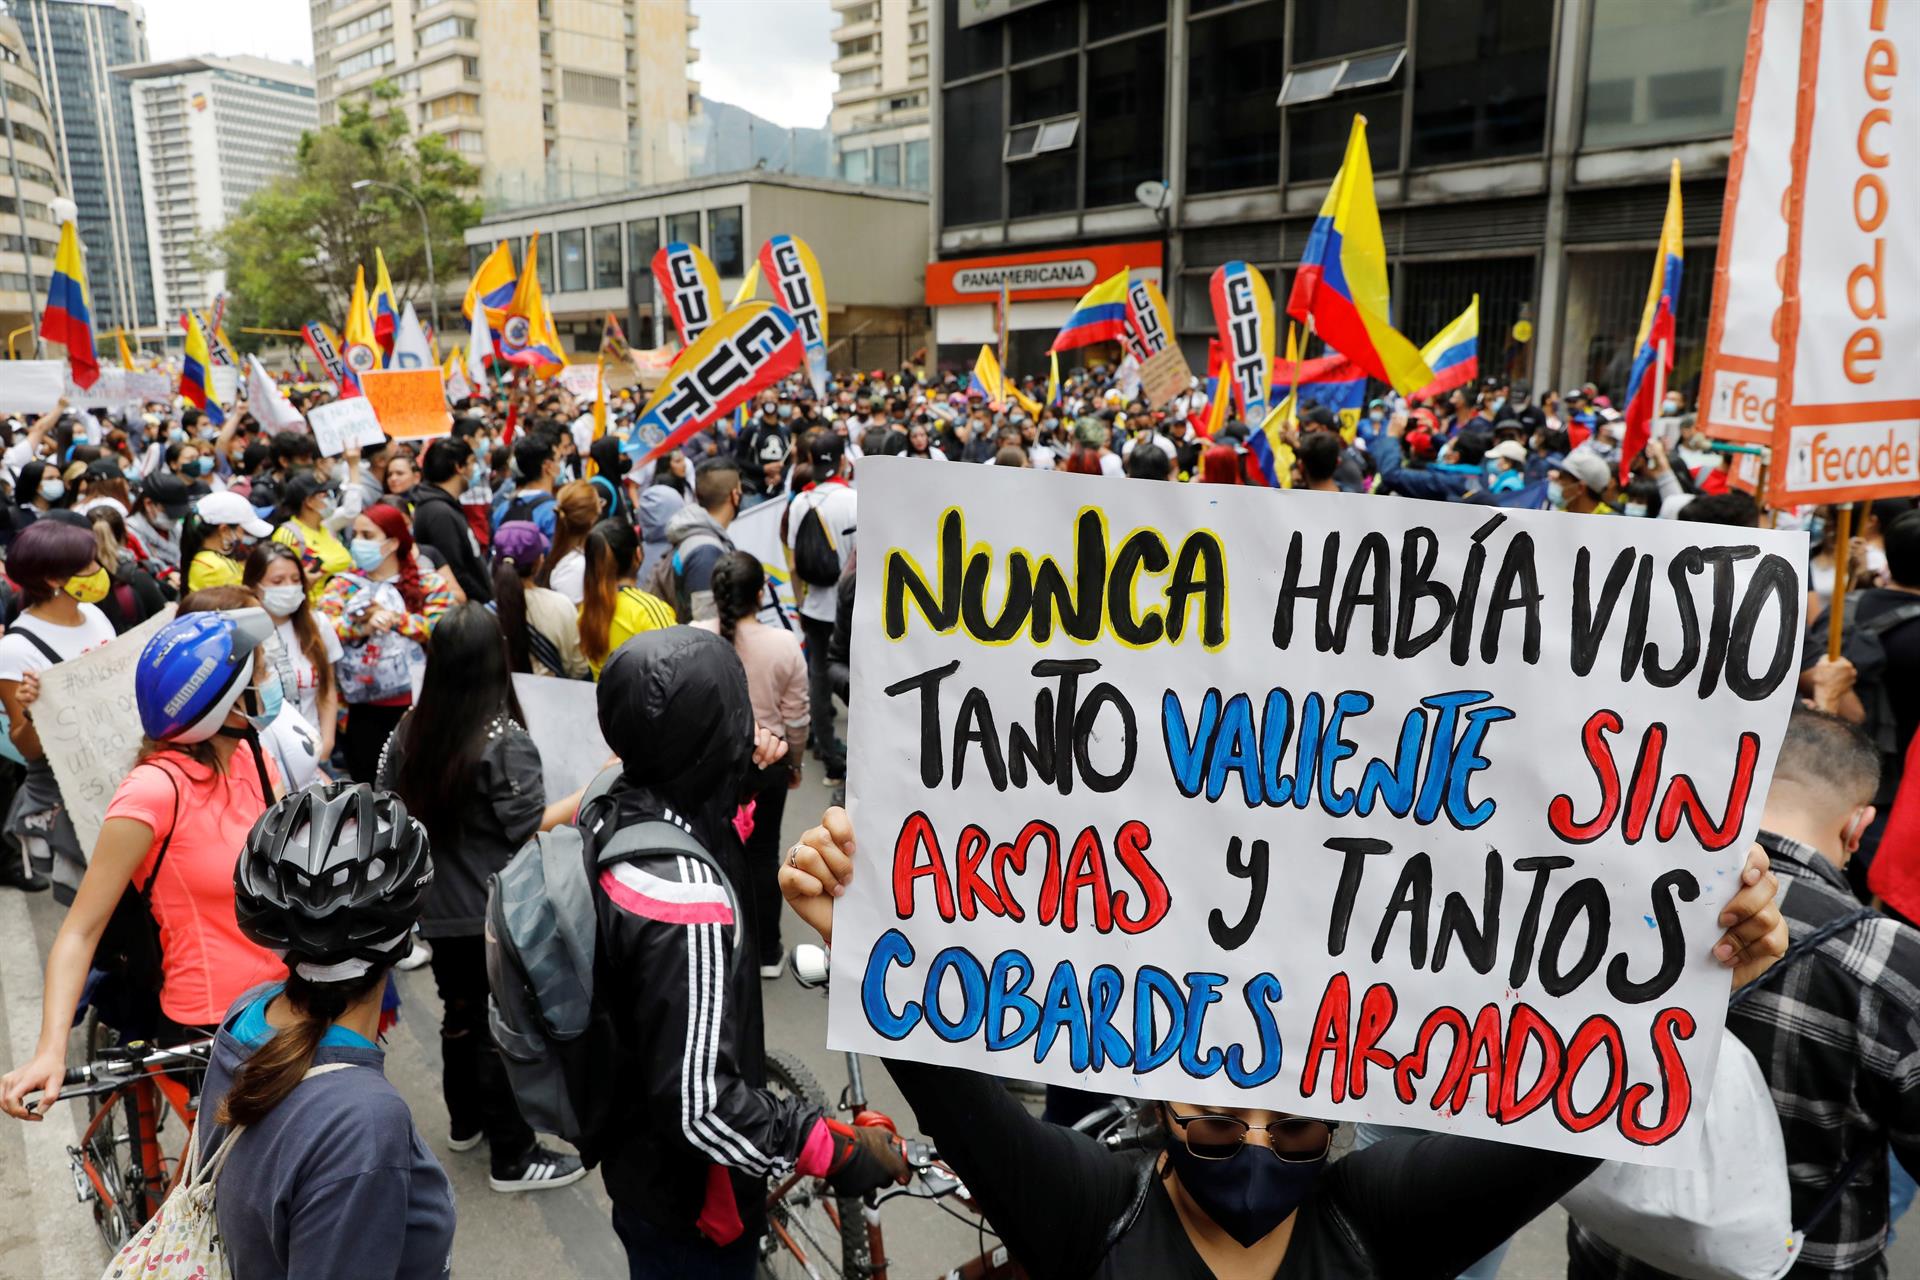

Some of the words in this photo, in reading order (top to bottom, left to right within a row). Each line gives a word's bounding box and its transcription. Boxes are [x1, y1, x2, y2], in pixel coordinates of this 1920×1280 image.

[776, 246, 819, 342] CUT
[961, 265, 1085, 288] PANAMERICANA
[312, 327, 342, 376] CUT
[662, 315, 785, 425] CUT
[1228, 277, 1264, 399] CUT
[1810, 428, 1910, 483] fecode
[883, 505, 1230, 653] NUNCA
[1272, 513, 1545, 666] HABÍA
[1570, 545, 1799, 701] VISTO
[163, 656, 219, 719] SHIMANO
[884, 658, 1138, 796] TANTO
[1162, 686, 1516, 830] VALIENTE
[1547, 709, 1761, 852] SIN
[892, 810, 1173, 935] ARMAS
[1323, 836, 1702, 1005] TANTOS
[861, 928, 1284, 1089] COBARDES
[1299, 971, 1697, 1147] ARMADOS
